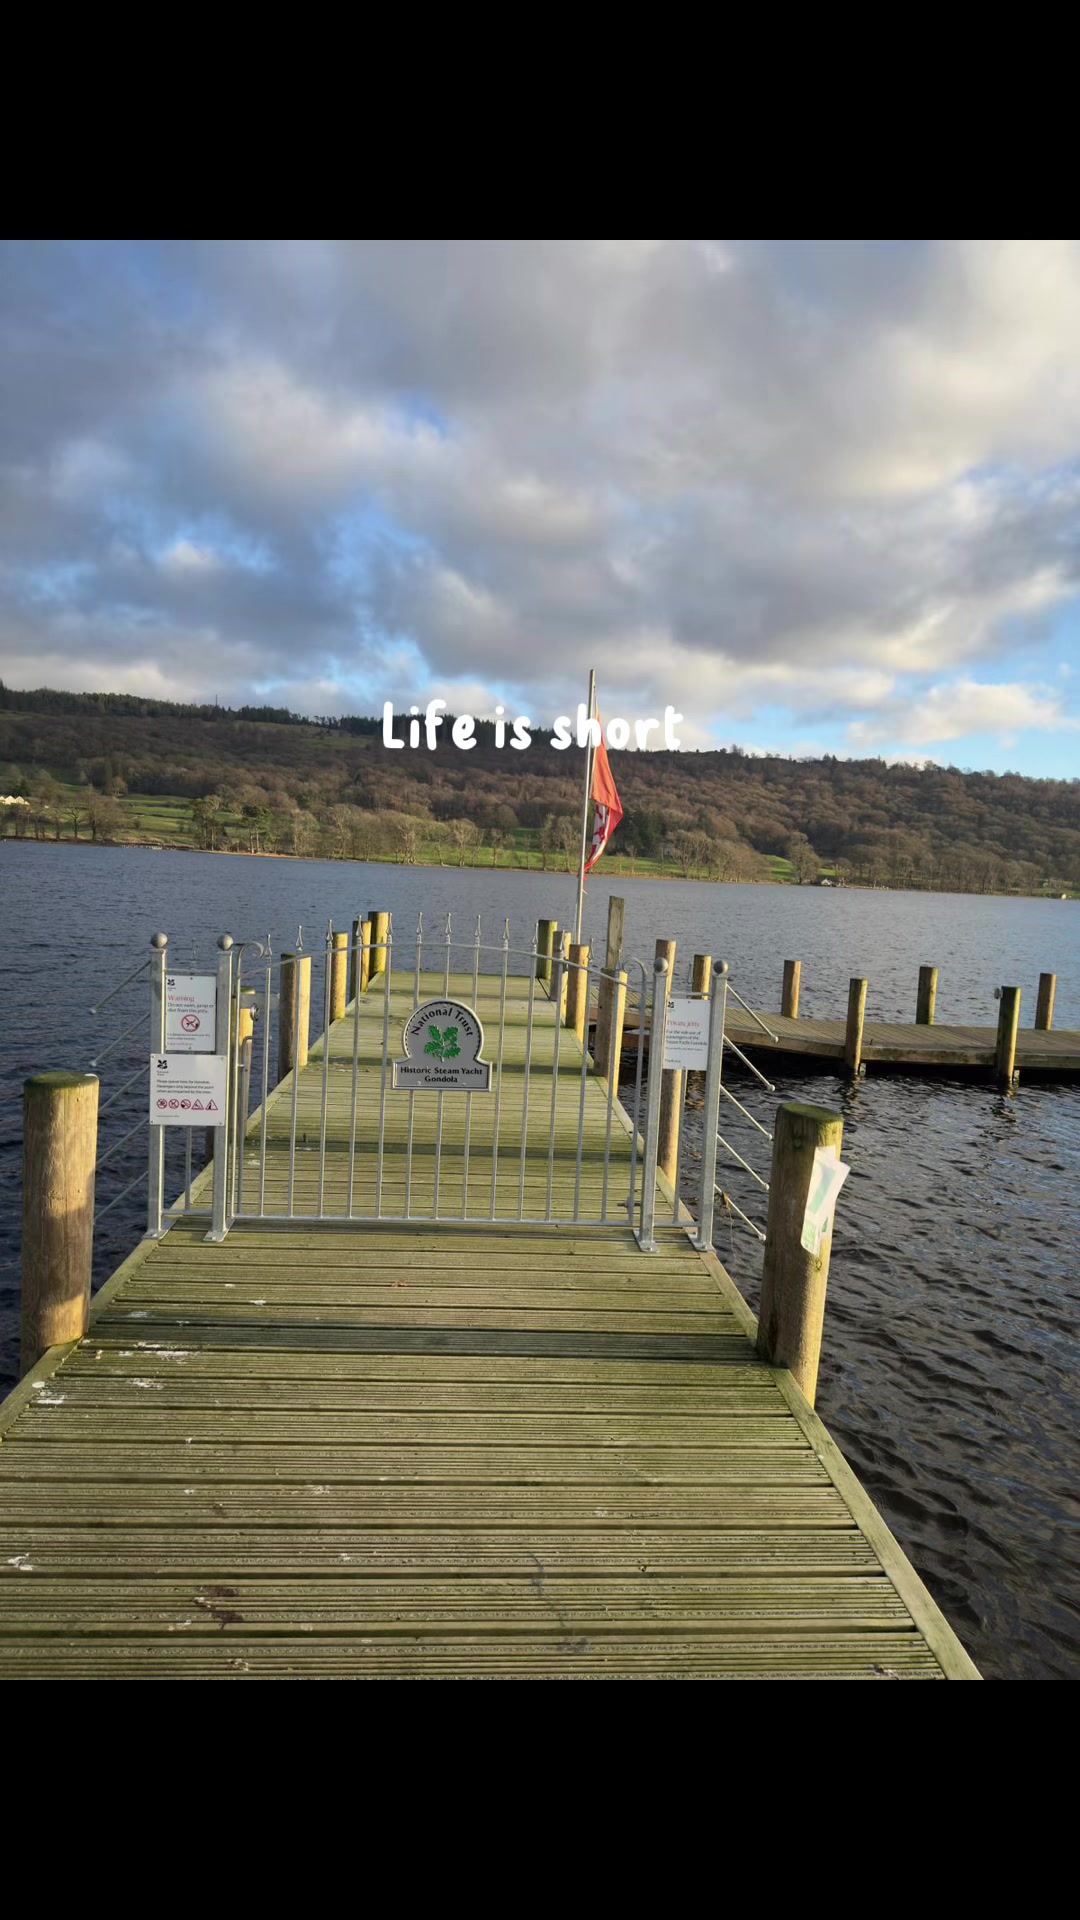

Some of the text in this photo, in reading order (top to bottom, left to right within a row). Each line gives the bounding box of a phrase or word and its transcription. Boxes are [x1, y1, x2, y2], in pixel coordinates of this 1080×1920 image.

[410, 1008, 474, 1036] National Trust
[400, 1066, 431, 1074] Historic
[461, 1067, 483, 1075] Yacht
[424, 1075, 458, 1083] Gondola
